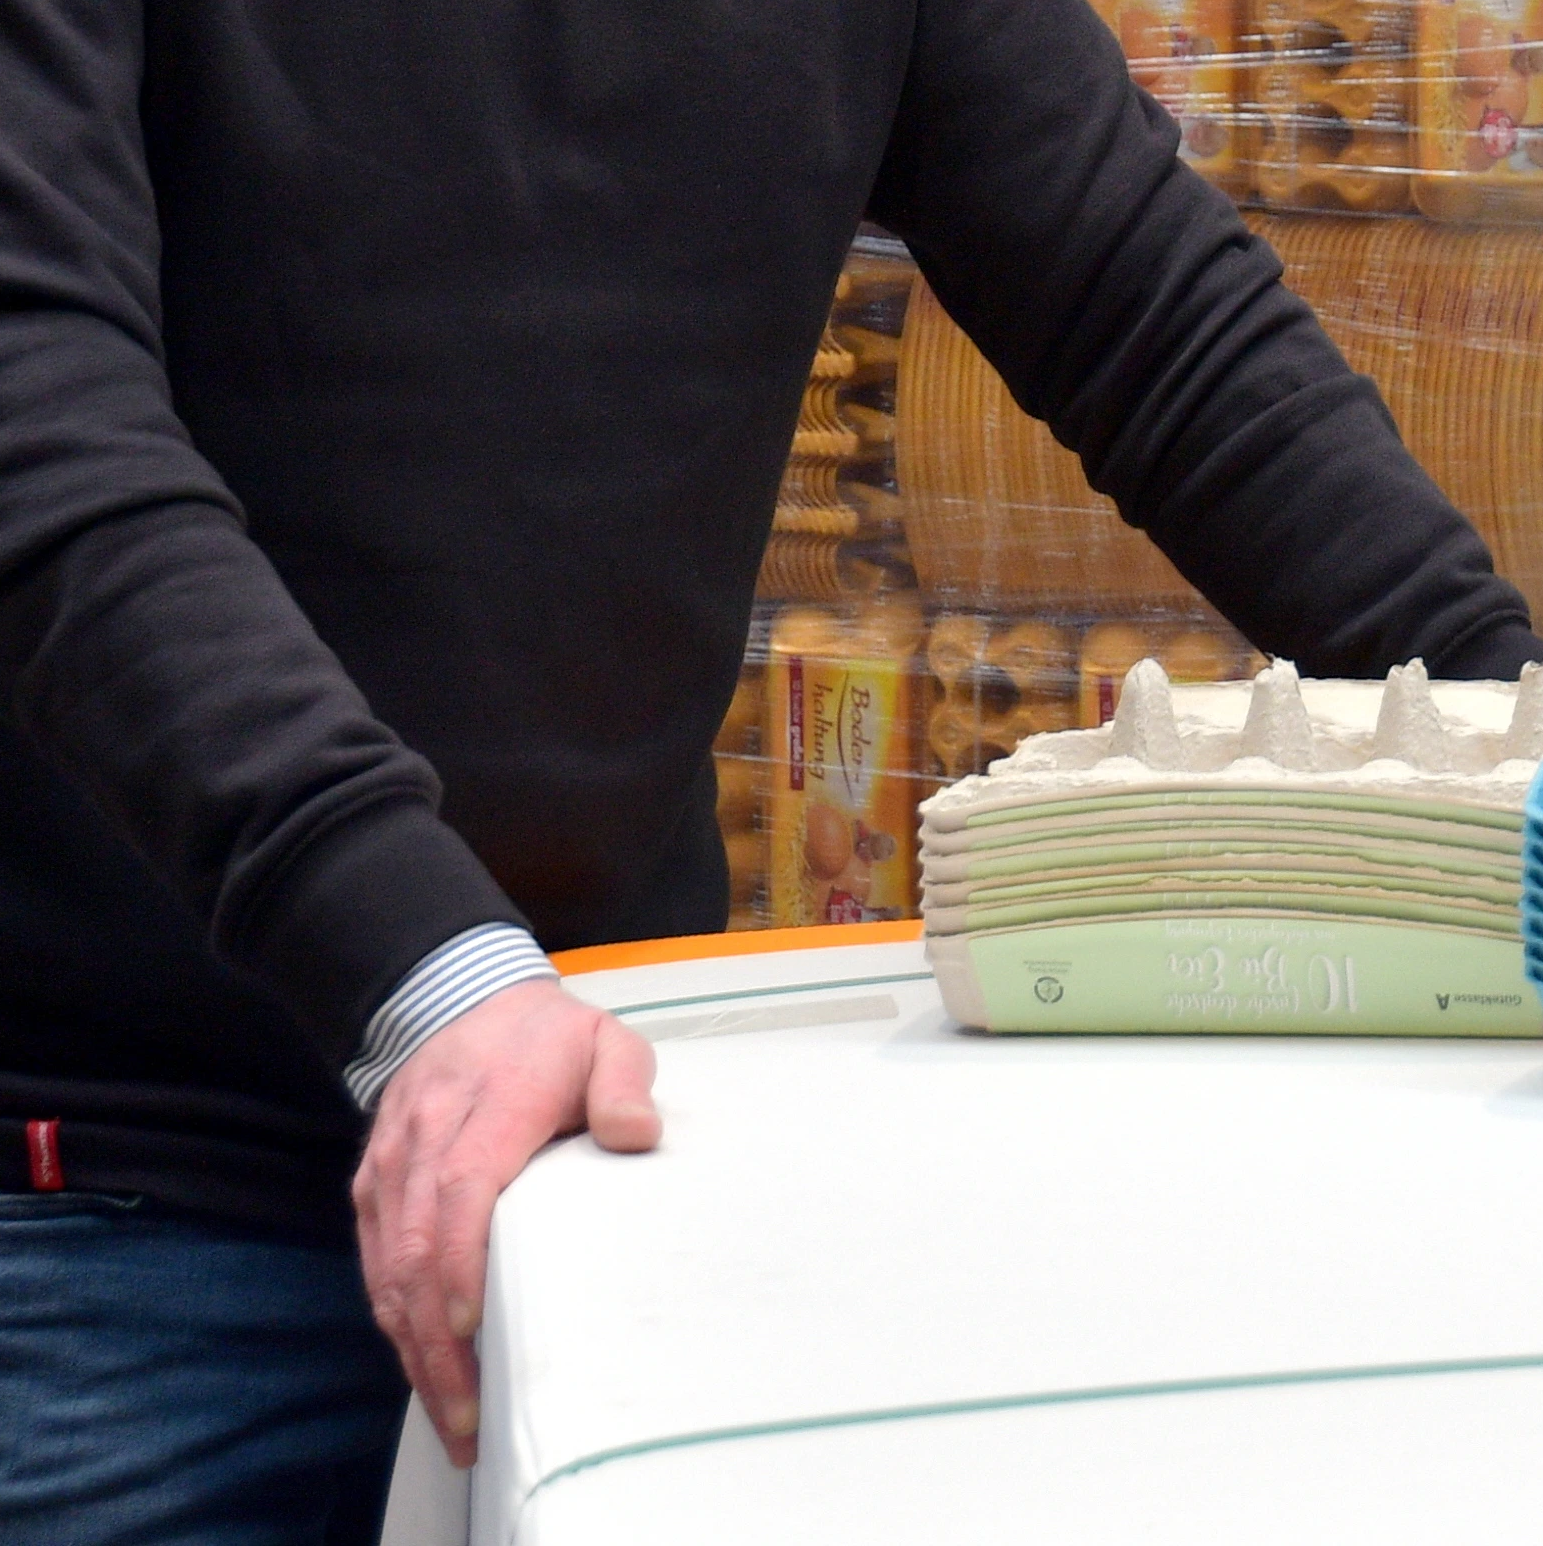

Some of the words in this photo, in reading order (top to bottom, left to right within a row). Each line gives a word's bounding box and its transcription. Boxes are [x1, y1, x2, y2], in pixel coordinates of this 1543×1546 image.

[809, 683, 833, 781] haltung
[1165, 947, 1225, 993] Eier
[1238, 946, 1289, 993] Bio
[1308, 954, 1358, 1014] 10
[1435, 994, 1450, 1011] A
[1454, 993, 1522, 1007] Güteklasse
